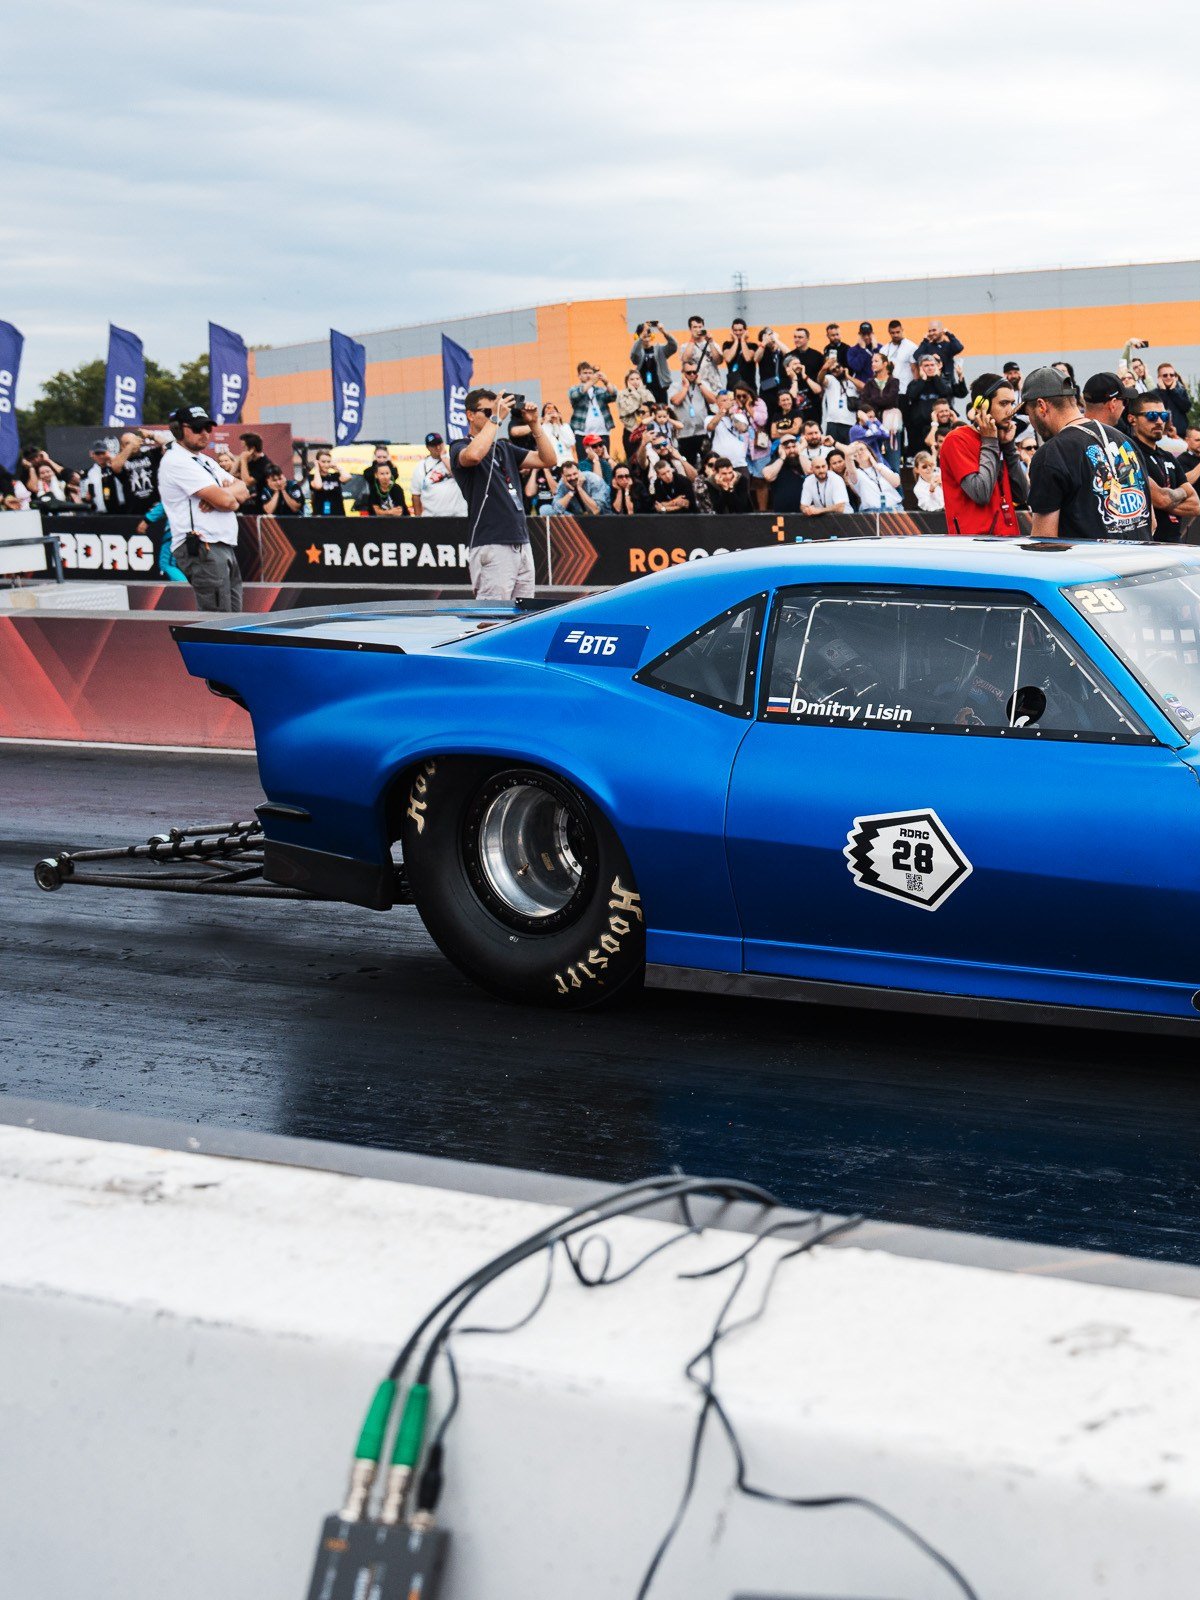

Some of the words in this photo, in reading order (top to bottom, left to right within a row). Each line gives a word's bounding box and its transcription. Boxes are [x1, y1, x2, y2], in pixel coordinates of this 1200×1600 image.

[114, 374, 137, 419] ВТБ
[221, 373, 243, 415] ВТБ
[342, 381, 360, 424] ВТБ
[449, 385, 468, 427] ВТБ
[1118, 493, 1143, 514] HRA
[1074, 588, 1125, 614] 28
[578, 635, 619, 656] ВТБ
[792, 698, 861, 721] Dmitry
[865, 703, 912, 722] Lisin
[900, 828, 930, 840] RDRC
[892, 840, 934, 875] 28
[555, 875, 643, 994] Hoosier
